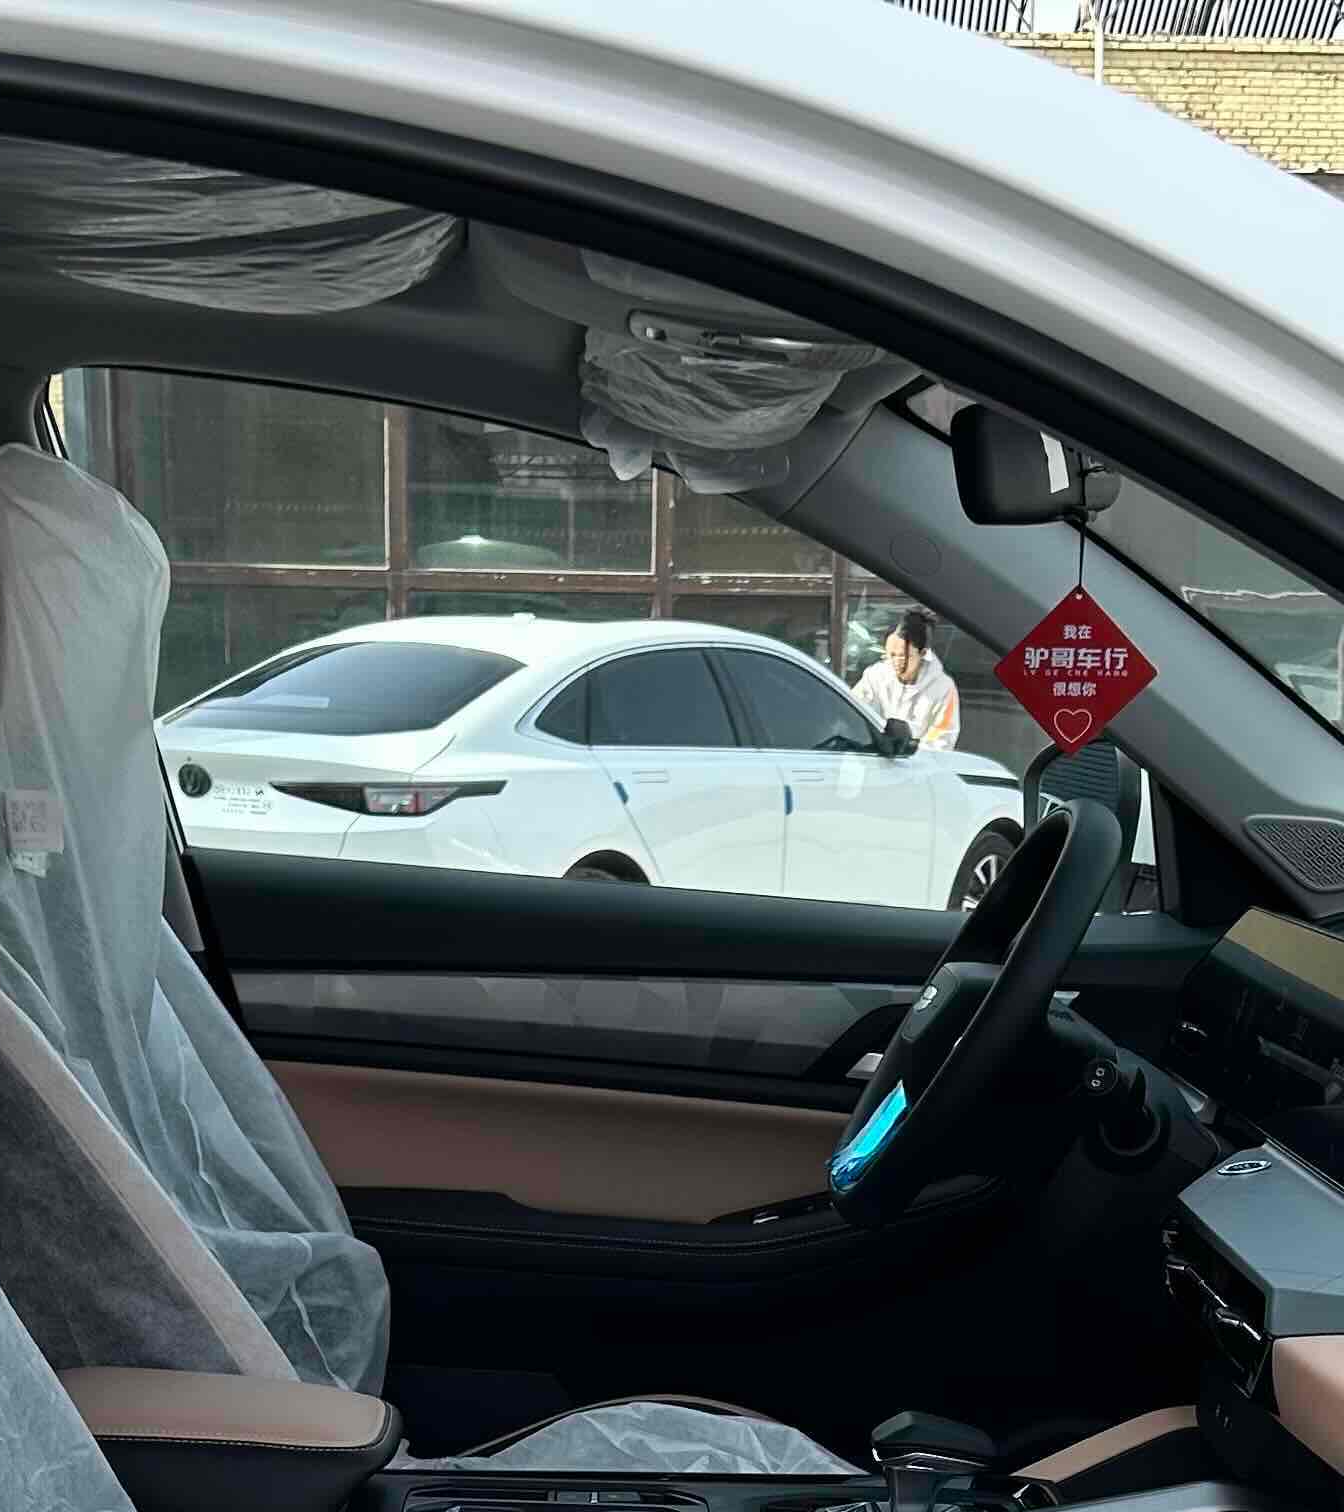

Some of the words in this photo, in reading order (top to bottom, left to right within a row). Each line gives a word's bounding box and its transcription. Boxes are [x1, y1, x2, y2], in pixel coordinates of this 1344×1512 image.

[1063, 624, 1093, 640] 我在
[1024, 647, 1129, 670] 驴哥车行
[1052, 681, 1097, 698] 很想你
